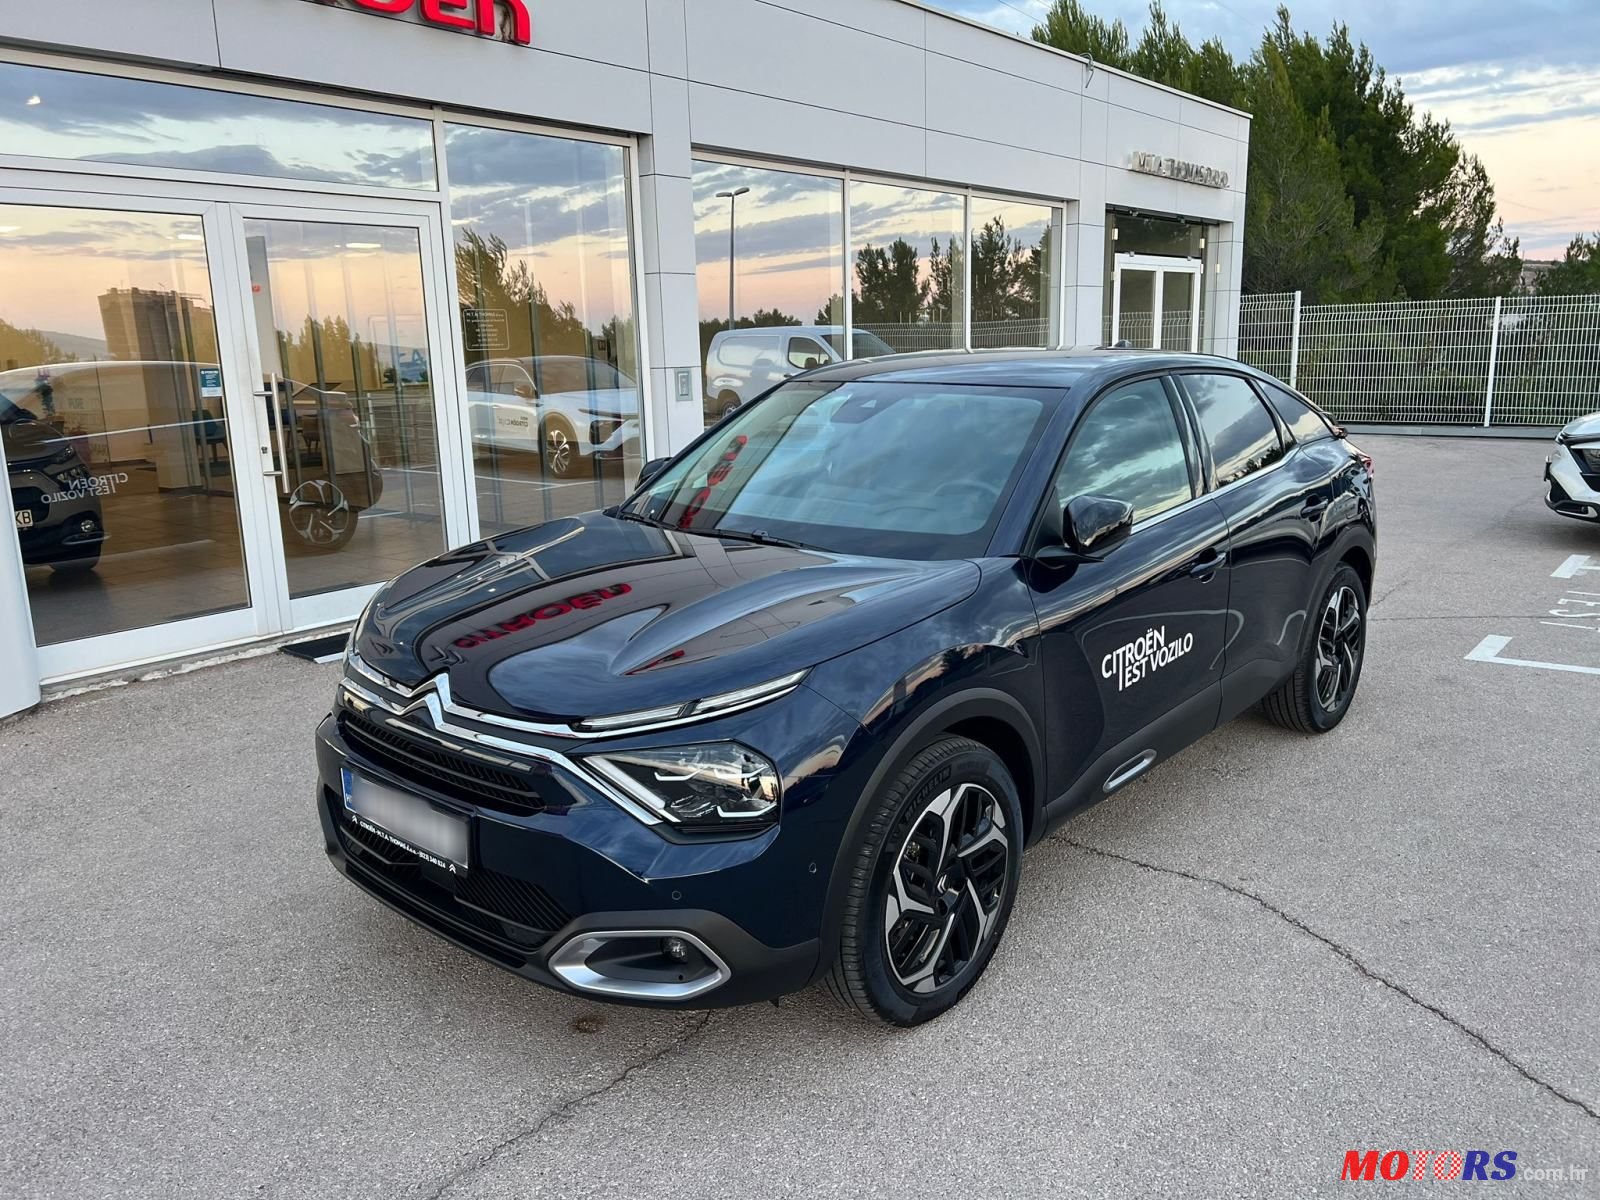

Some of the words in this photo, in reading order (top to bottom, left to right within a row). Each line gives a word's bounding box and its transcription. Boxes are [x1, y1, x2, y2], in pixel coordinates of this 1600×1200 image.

[1101, 625, 1165, 680] CITROËN
[1119, 656, 1148, 691] TEST
[1150, 632, 1193, 671] VOZILO
